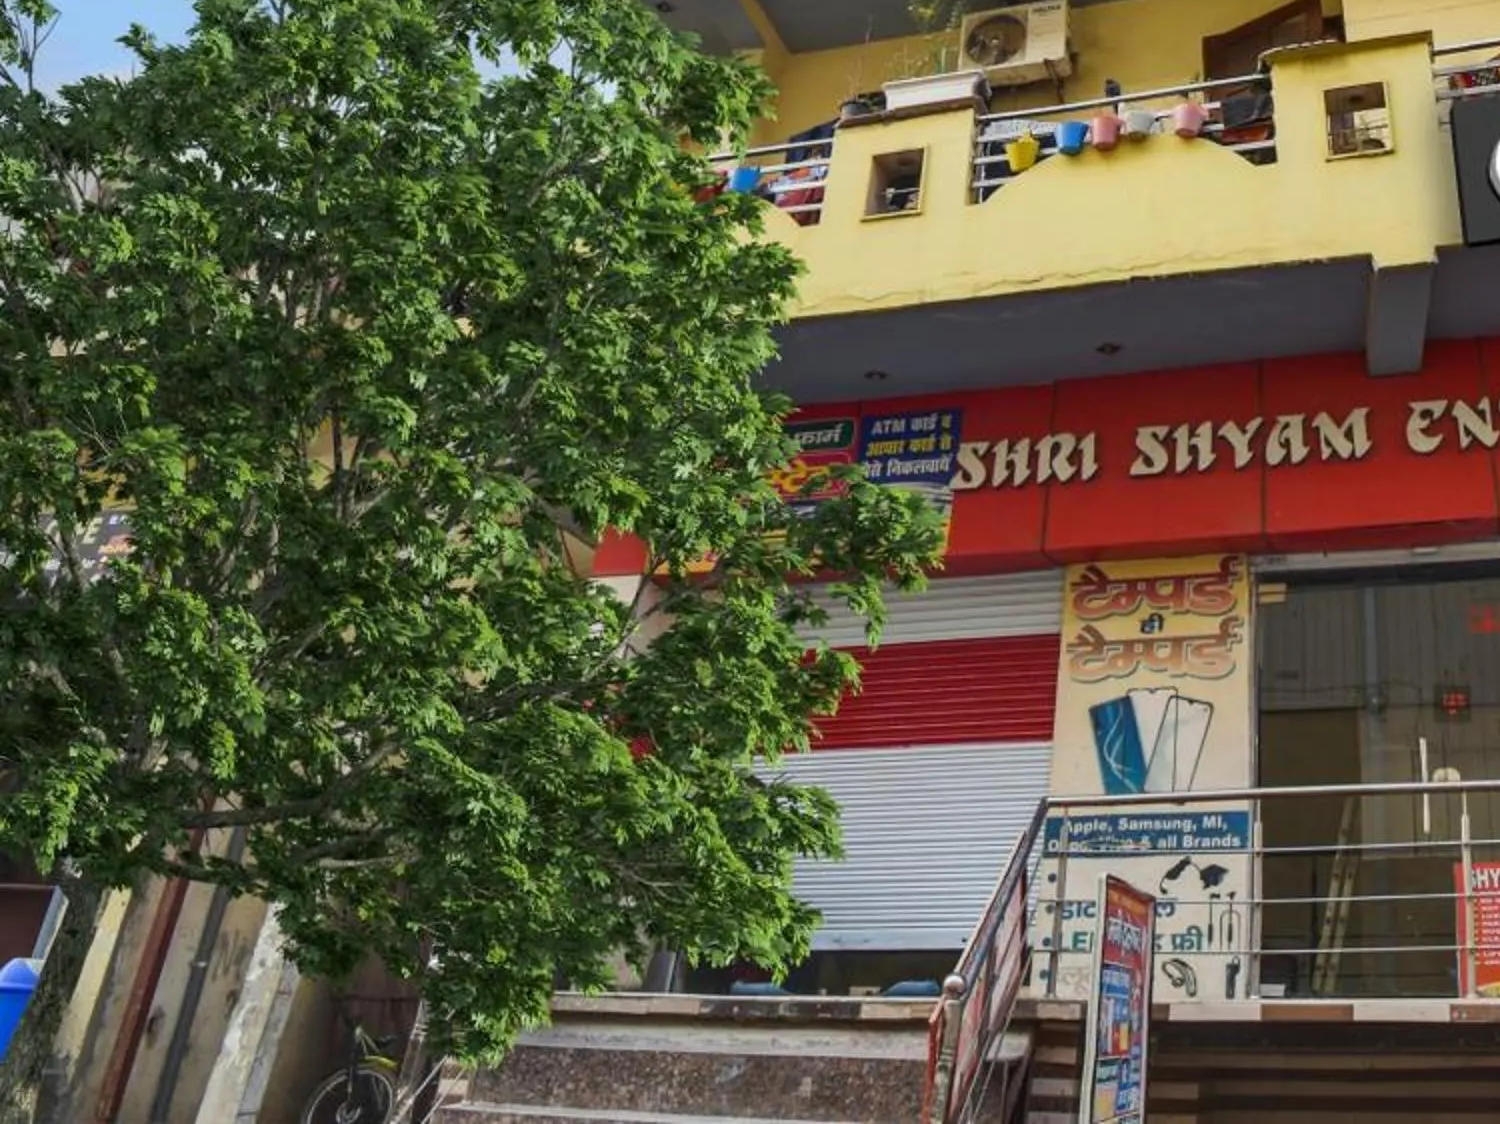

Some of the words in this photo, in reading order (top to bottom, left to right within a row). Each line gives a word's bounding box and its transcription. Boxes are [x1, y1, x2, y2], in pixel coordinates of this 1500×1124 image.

[871, 418, 906, 435] ATM
[949, 431, 1100, 490] SHRI
[1129, 406, 1373, 477] SHYAM
[1118, 815, 1198, 833] Samsung,
[1156, 833, 1178, 849] all
[1182, 832, 1241, 848] Brands
